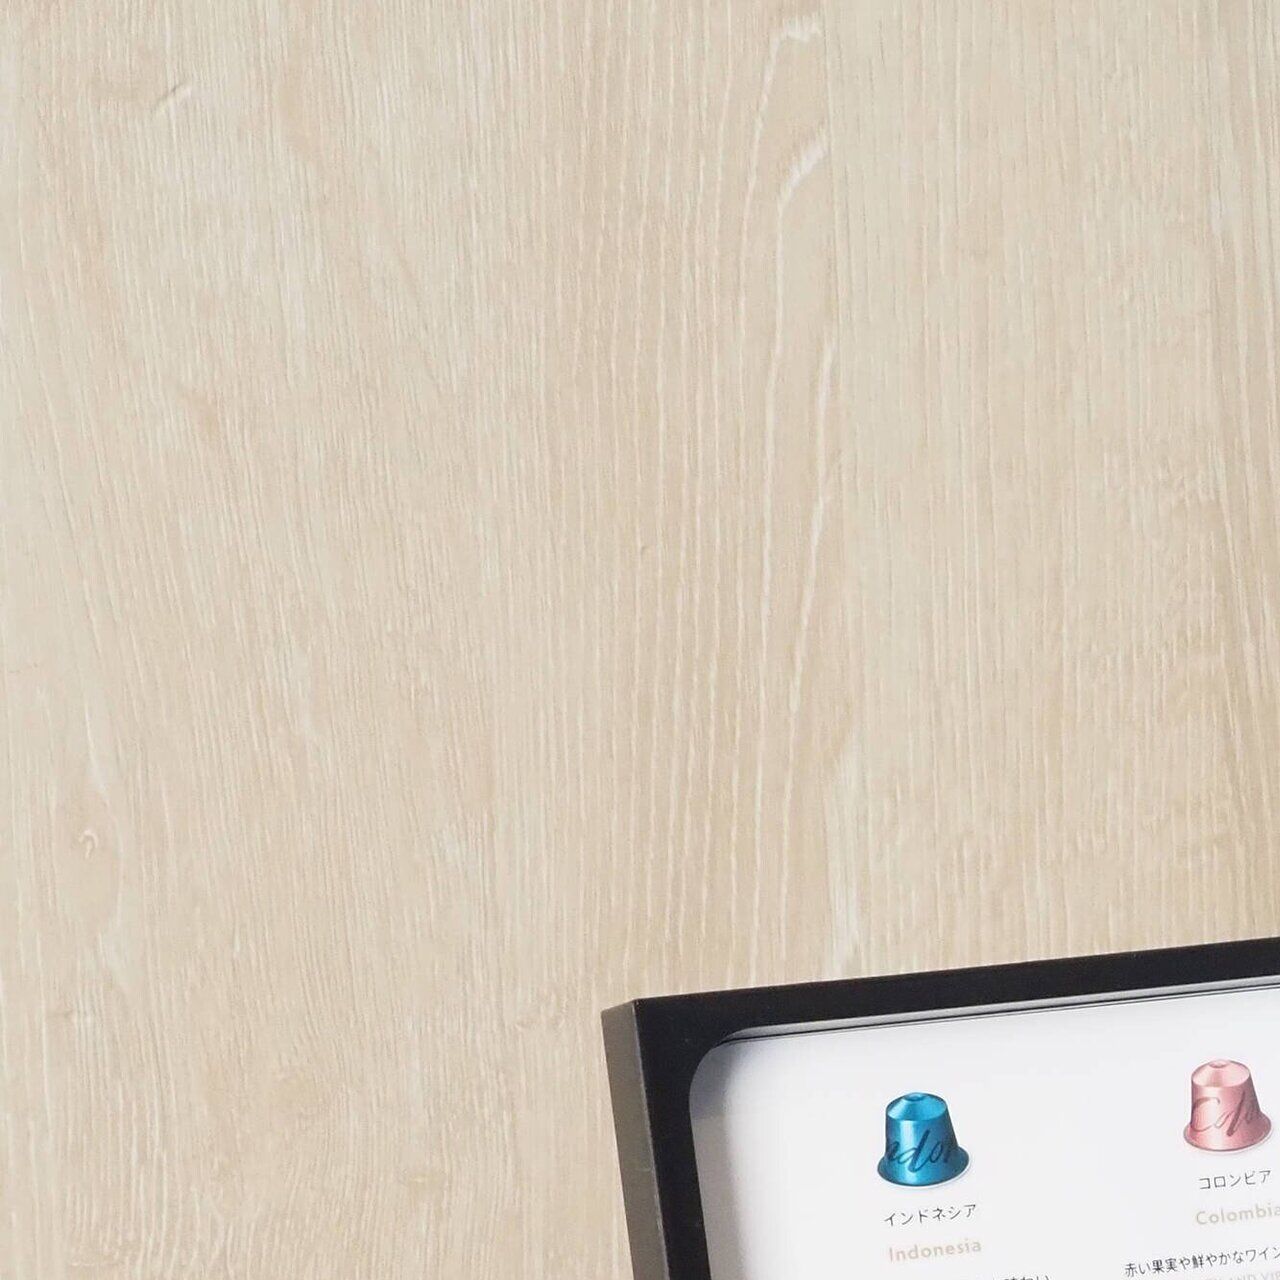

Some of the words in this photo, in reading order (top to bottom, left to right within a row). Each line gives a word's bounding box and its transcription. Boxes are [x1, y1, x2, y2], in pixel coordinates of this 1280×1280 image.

[1199, 1169, 1272, 1190] コロンビア
[884, 1203, 977, 1227] インドネシア
[888, 1238, 982, 1263] Indonesia
